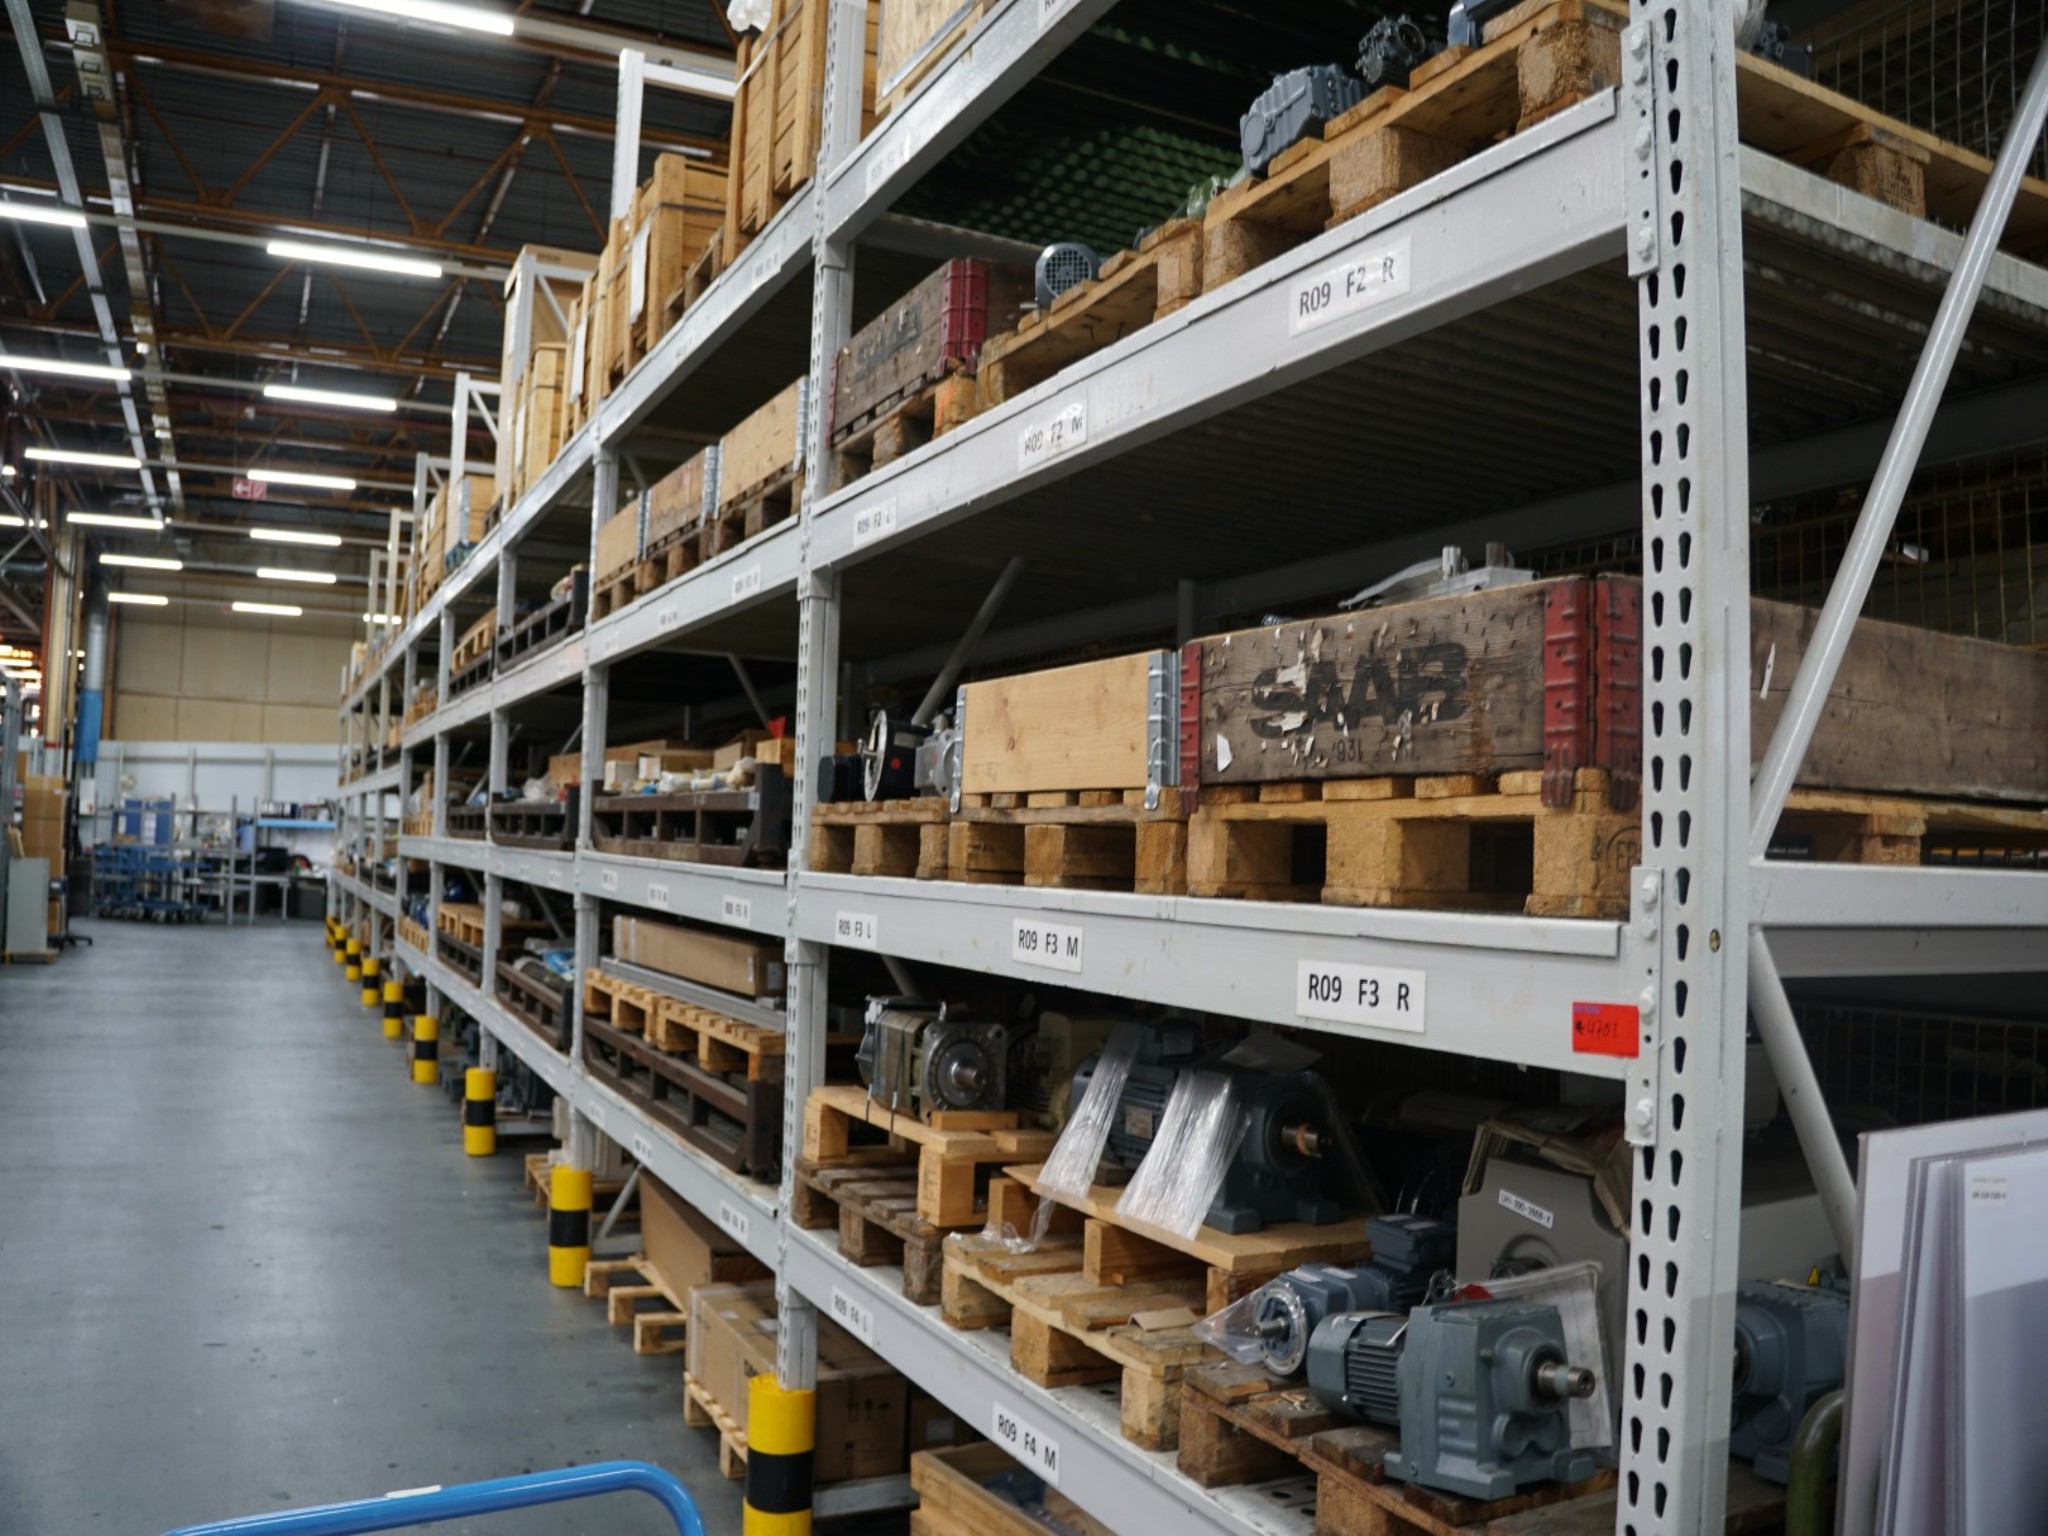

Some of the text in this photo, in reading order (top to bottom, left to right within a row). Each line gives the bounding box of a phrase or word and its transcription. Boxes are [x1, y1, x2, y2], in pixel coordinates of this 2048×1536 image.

[1299, 256, 1394, 317] R09 F2 R
[1024, 428, 1044, 457] R09
[1050, 419, 1063, 444] F2
[1249, 642, 1470, 741] SAAB
[855, 920, 863, 939] F3
[1018, 928, 1079, 958] R09 F3 M
[1308, 973, 1410, 1012] R09 F3 R
[998, 1413, 1056, 1472] R09 F4 M
